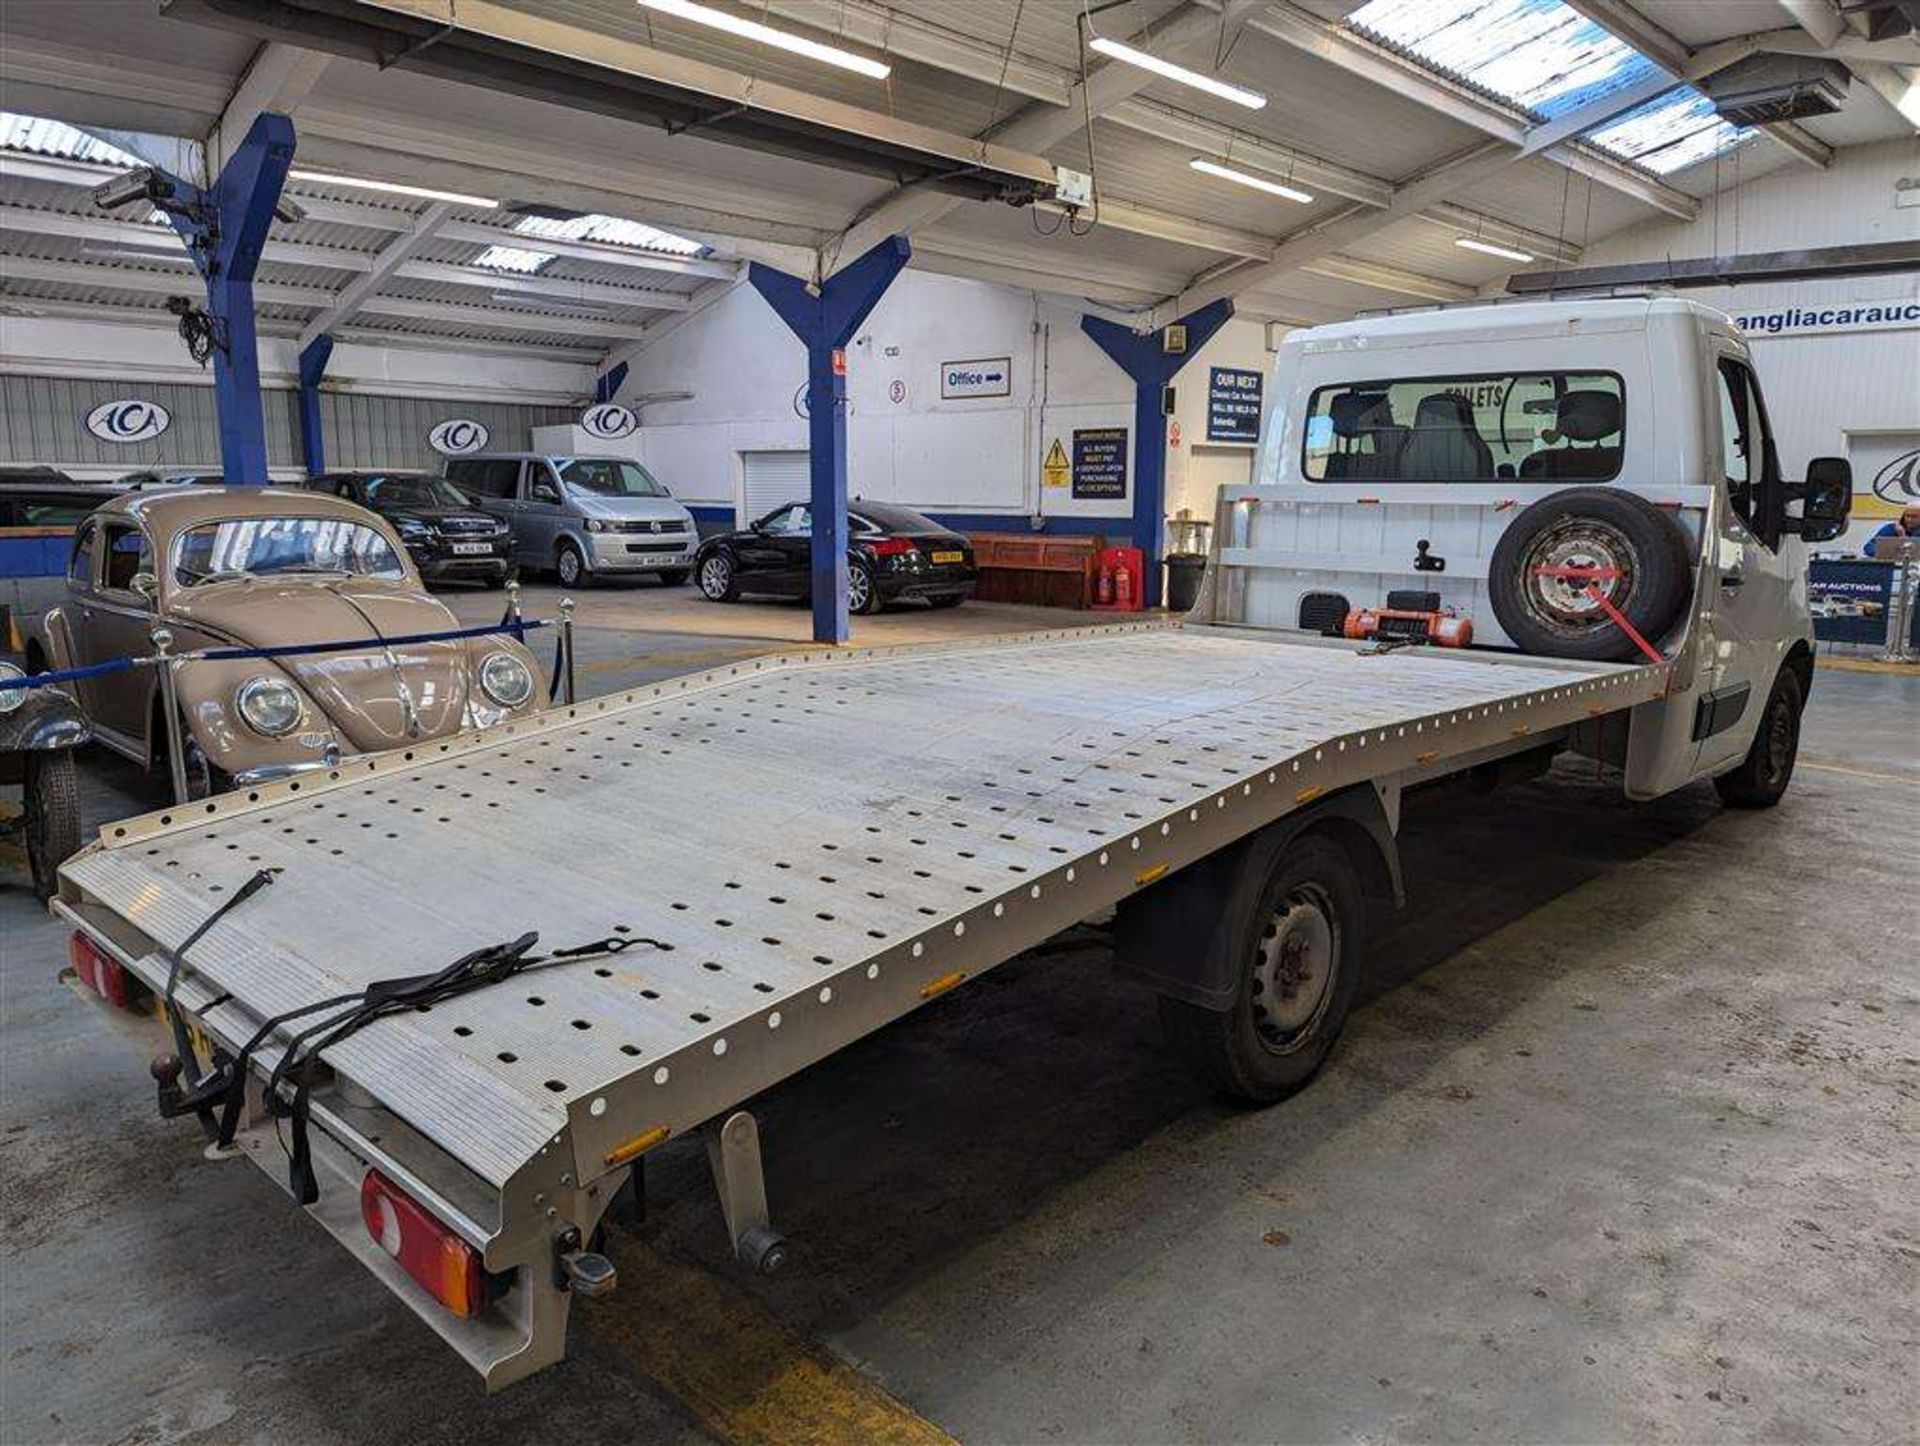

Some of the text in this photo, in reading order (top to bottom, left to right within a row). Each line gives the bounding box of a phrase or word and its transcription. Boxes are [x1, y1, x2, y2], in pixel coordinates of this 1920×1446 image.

[1736, 303, 1920, 333] angliacarauc
[948, 371, 983, 386] Office
[1216, 373, 1258, 389] OUR NEXT
[1212, 402, 1259, 415] WILL BE HELD ON
[1083, 444, 1117, 453] ALL BUYERS
[1102, 454, 1115, 462] PAY
[1080, 464, 1105, 472] DEPOSIT
[1080, 474, 1119, 482] PURCHASING
[1085, 484, 1122, 492] EXCEPTIONS
[1828, 582, 1882, 593] AUCTIONS
